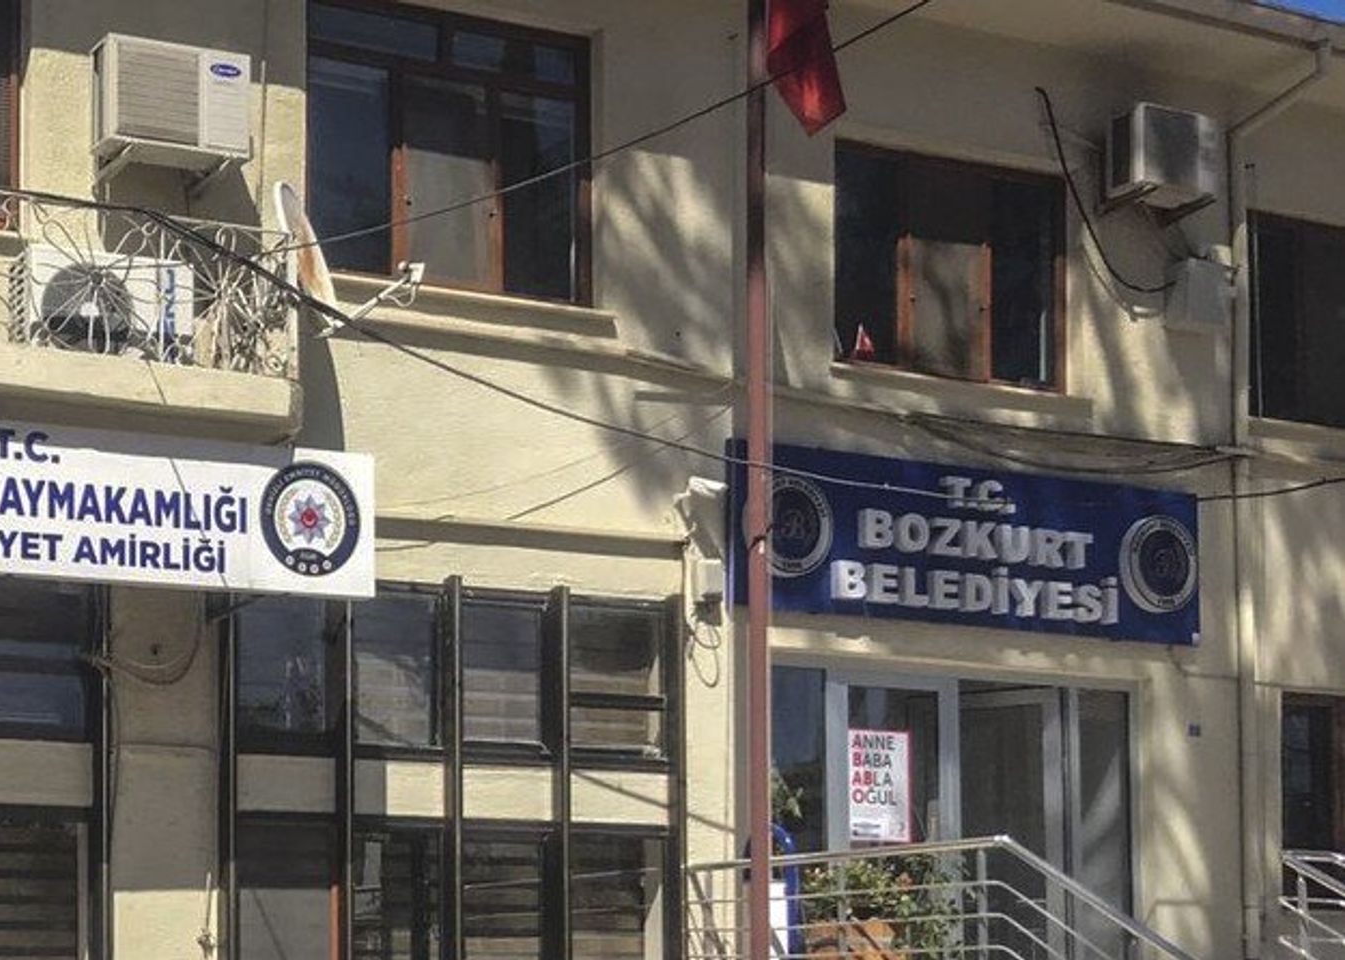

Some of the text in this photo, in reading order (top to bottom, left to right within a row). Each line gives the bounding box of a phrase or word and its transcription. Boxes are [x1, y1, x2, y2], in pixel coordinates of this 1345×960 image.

[939, 475, 1016, 514] T.C.
[858, 508, 1093, 569] BOZKURT
[73, 533, 226, 574] AMİRLİĞİ
[830, 559, 1119, 625] BELEDİYESİ
[852, 734, 895, 750] ANNE
[852, 751, 892, 768] BABA
[852, 770, 893, 787] ABLA
[852, 787, 897, 806] OĞUL
